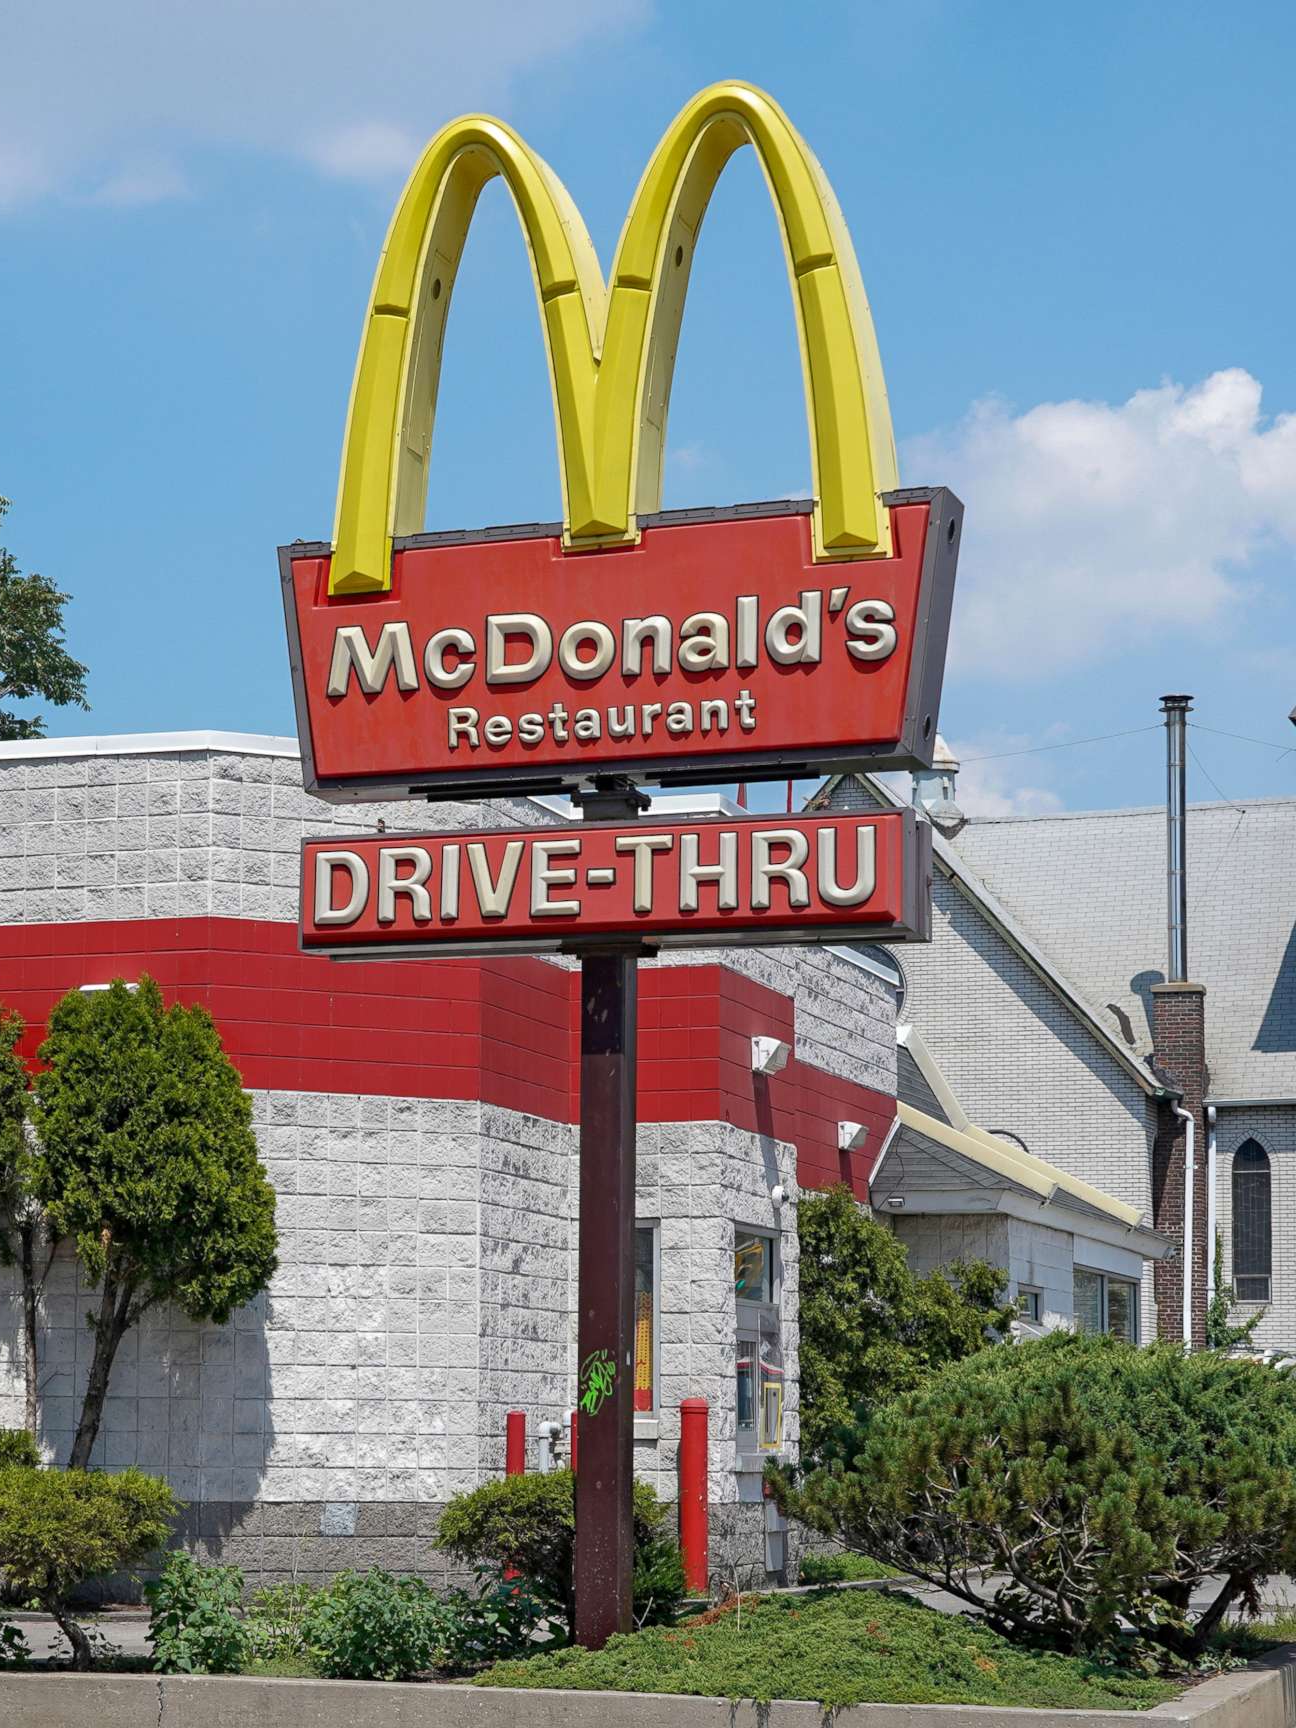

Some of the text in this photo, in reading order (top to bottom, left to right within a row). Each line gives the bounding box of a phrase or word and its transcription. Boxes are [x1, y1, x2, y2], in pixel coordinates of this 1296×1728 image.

[327, 587, 898, 697] McDonald's
[448, 690, 757, 749] Restaurant
[314, 825, 877, 925] DRIVE-THRU
